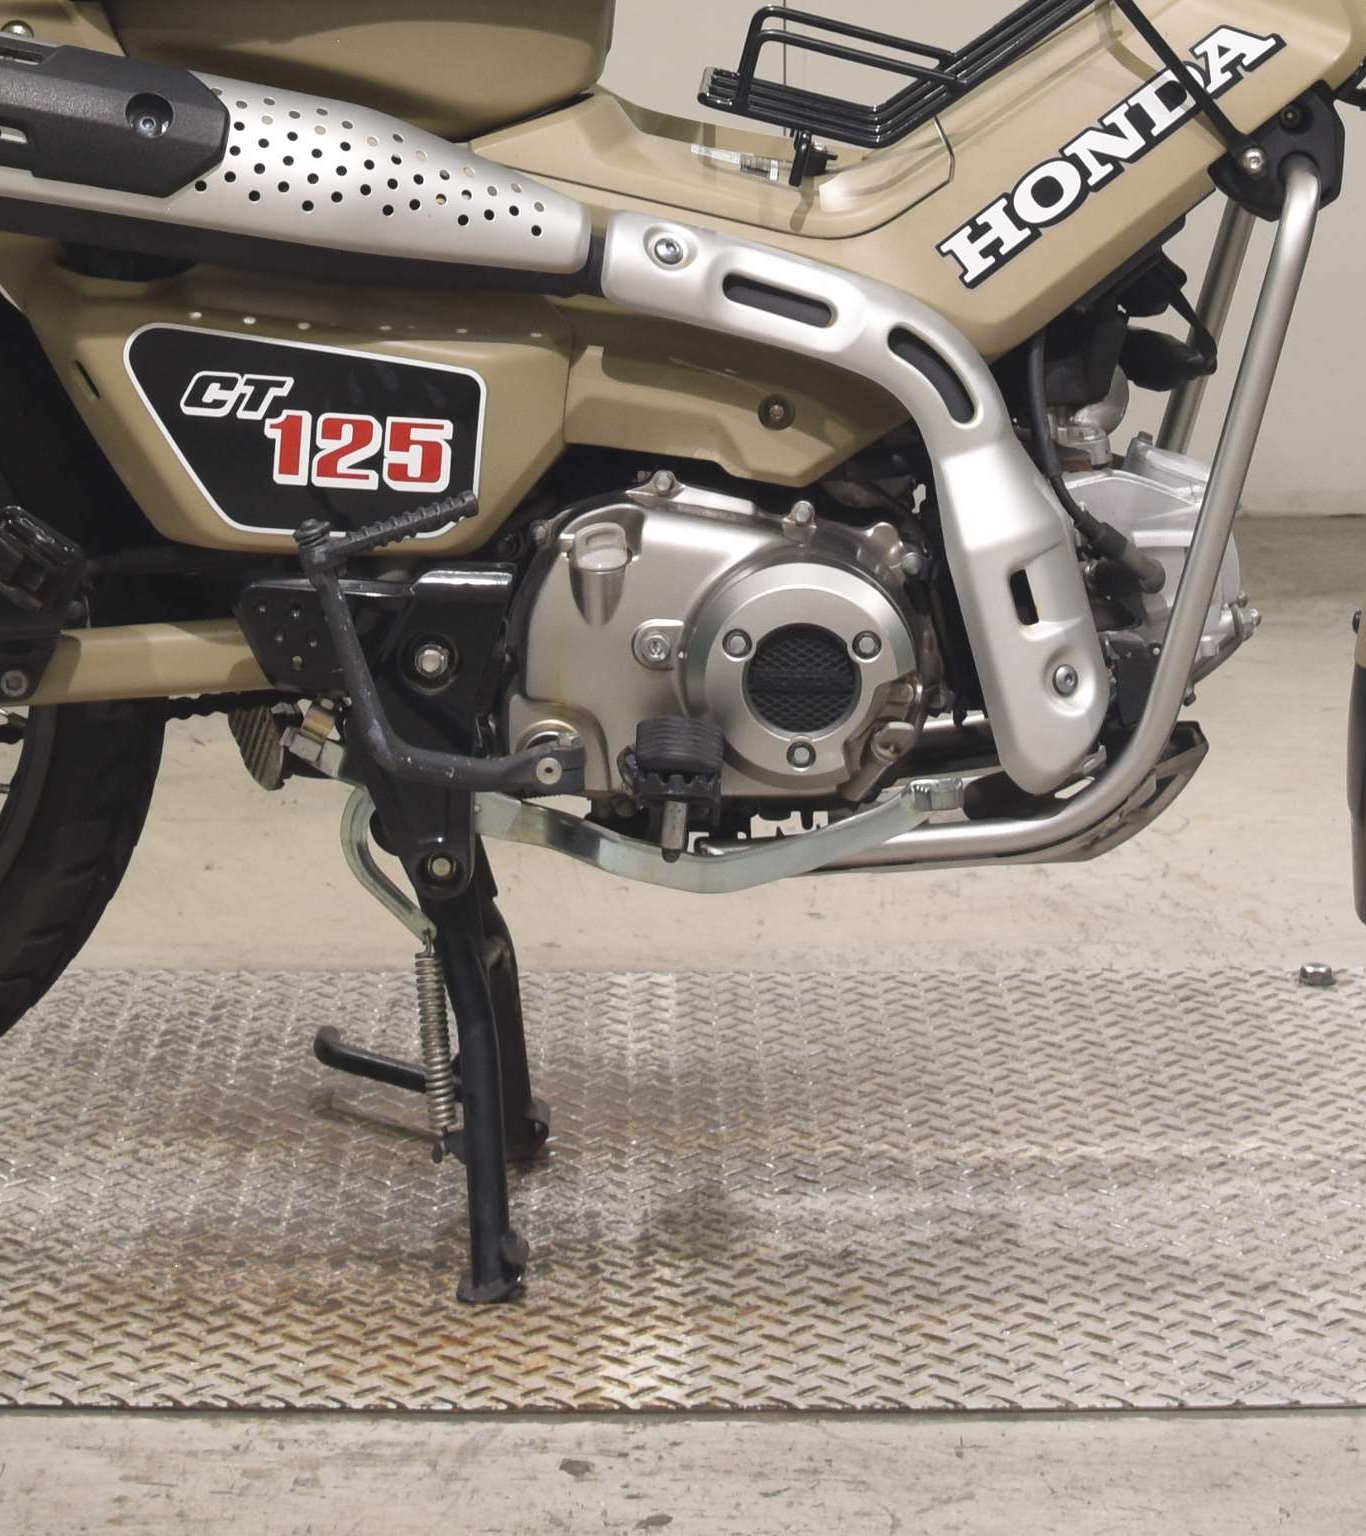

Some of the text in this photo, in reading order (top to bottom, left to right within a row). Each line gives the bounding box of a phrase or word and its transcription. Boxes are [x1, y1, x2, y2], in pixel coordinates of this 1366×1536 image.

[935, 24, 1287, 290] HONDA
[180, 370, 295, 421] CT
[264, 409, 454, 493] 125
